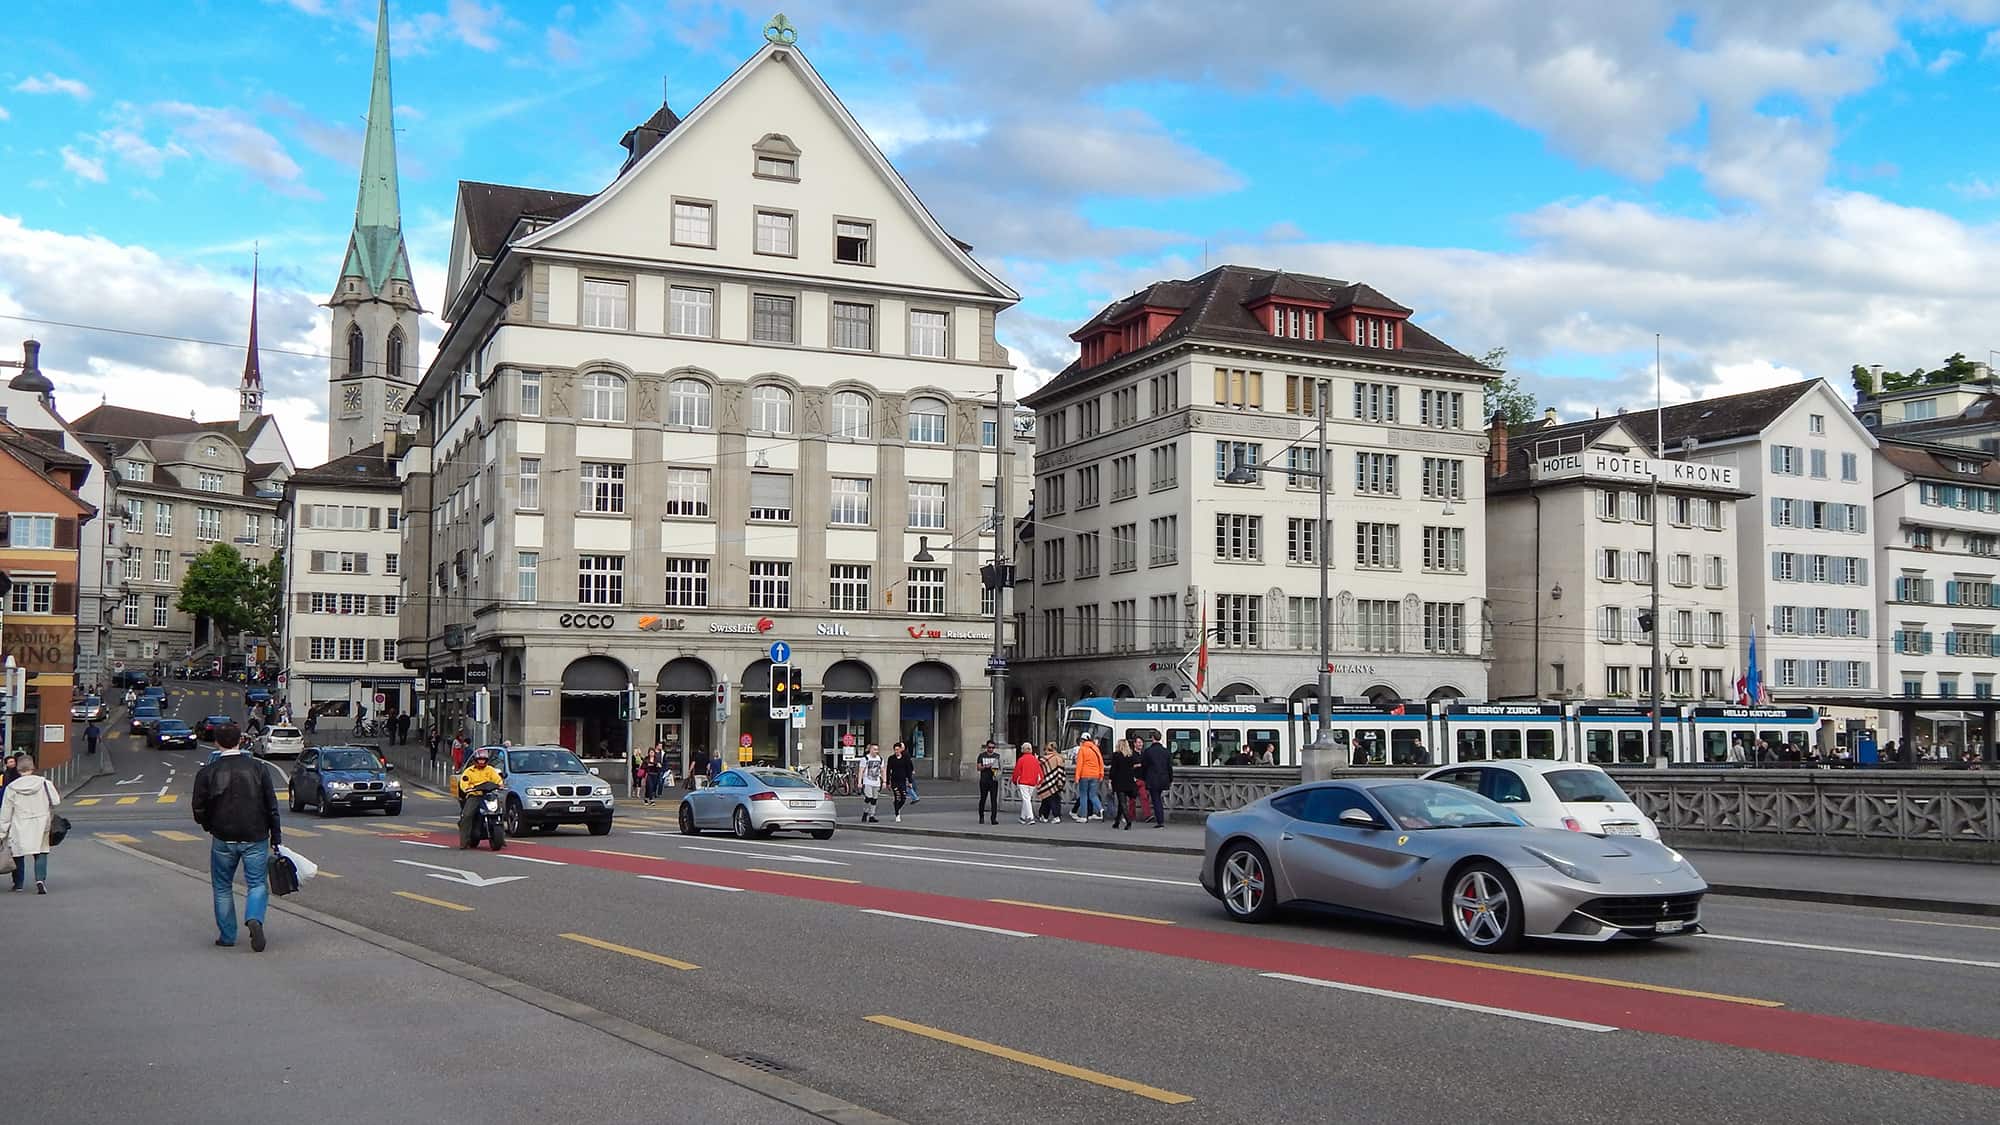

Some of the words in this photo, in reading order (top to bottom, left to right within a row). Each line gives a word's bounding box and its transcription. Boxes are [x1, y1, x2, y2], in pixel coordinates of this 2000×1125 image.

[1543, 455, 1582, 473] HOTEL
[1596, 455, 1652, 475] HOTEL
[1674, 463, 1731, 483] KRONE
[559, 613, 615, 629] ecco
[1318, 663, 1376, 674] OMPANYS
[1146, 703, 1158, 712] HI
[1160, 703, 1196, 712] LITTLE
[1198, 704, 1257, 713] MONSTERS
[1467, 706, 1505, 714] ENERGY
[1506, 706, 1541, 715] ZURICH
[1723, 709, 1748, 717] HELLO
